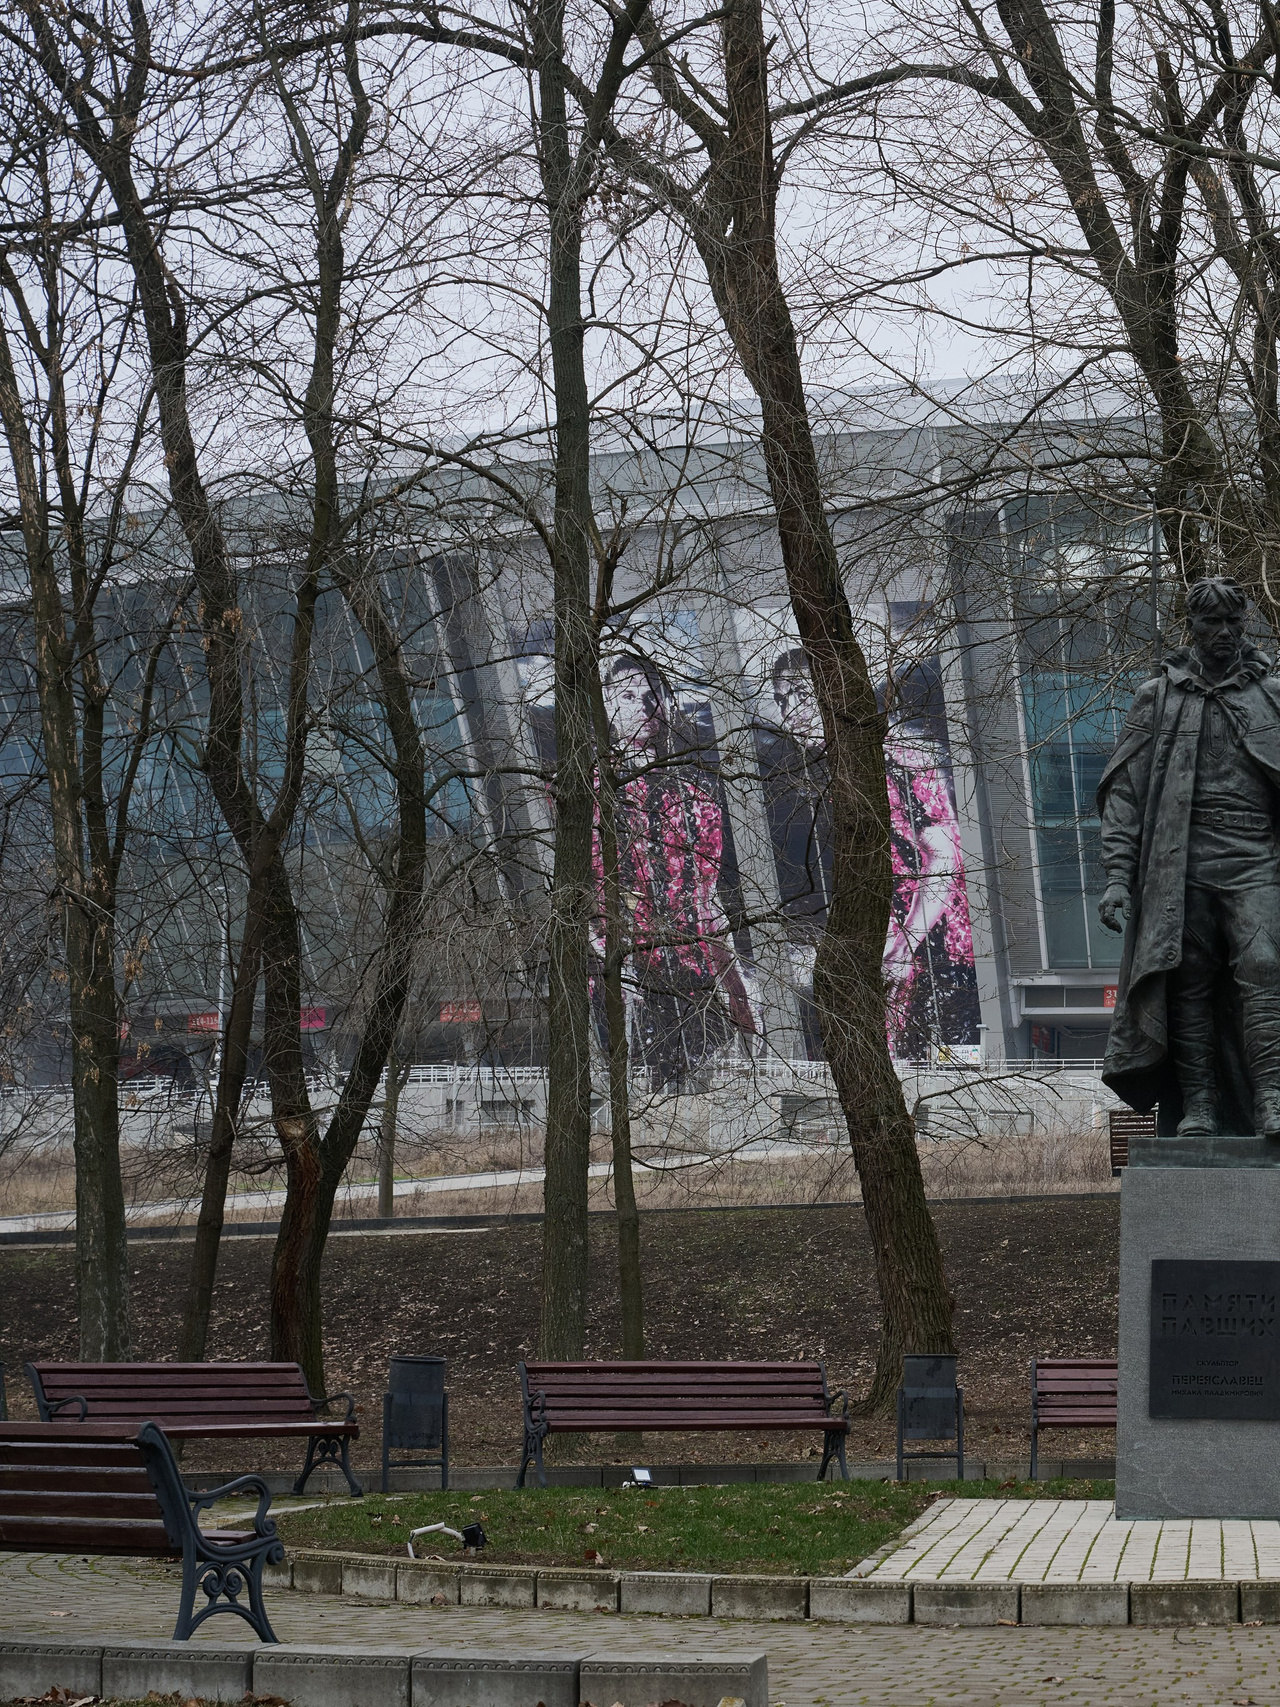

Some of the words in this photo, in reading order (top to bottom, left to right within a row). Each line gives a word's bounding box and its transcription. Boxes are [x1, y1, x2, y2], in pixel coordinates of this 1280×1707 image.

[1162, 1293, 1276, 1313] ПАМЯТИ
[1161, 1317, 1275, 1336] ПАВШИХ
[1172, 1375, 1264, 1386] ПЕРЕЯСЛАВЕЦ
[1171, 1389, 1202, 1397] МИХАИЛ
[1204, 1389, 1264, 1397] ВЛАДИМИРОВИЧ
